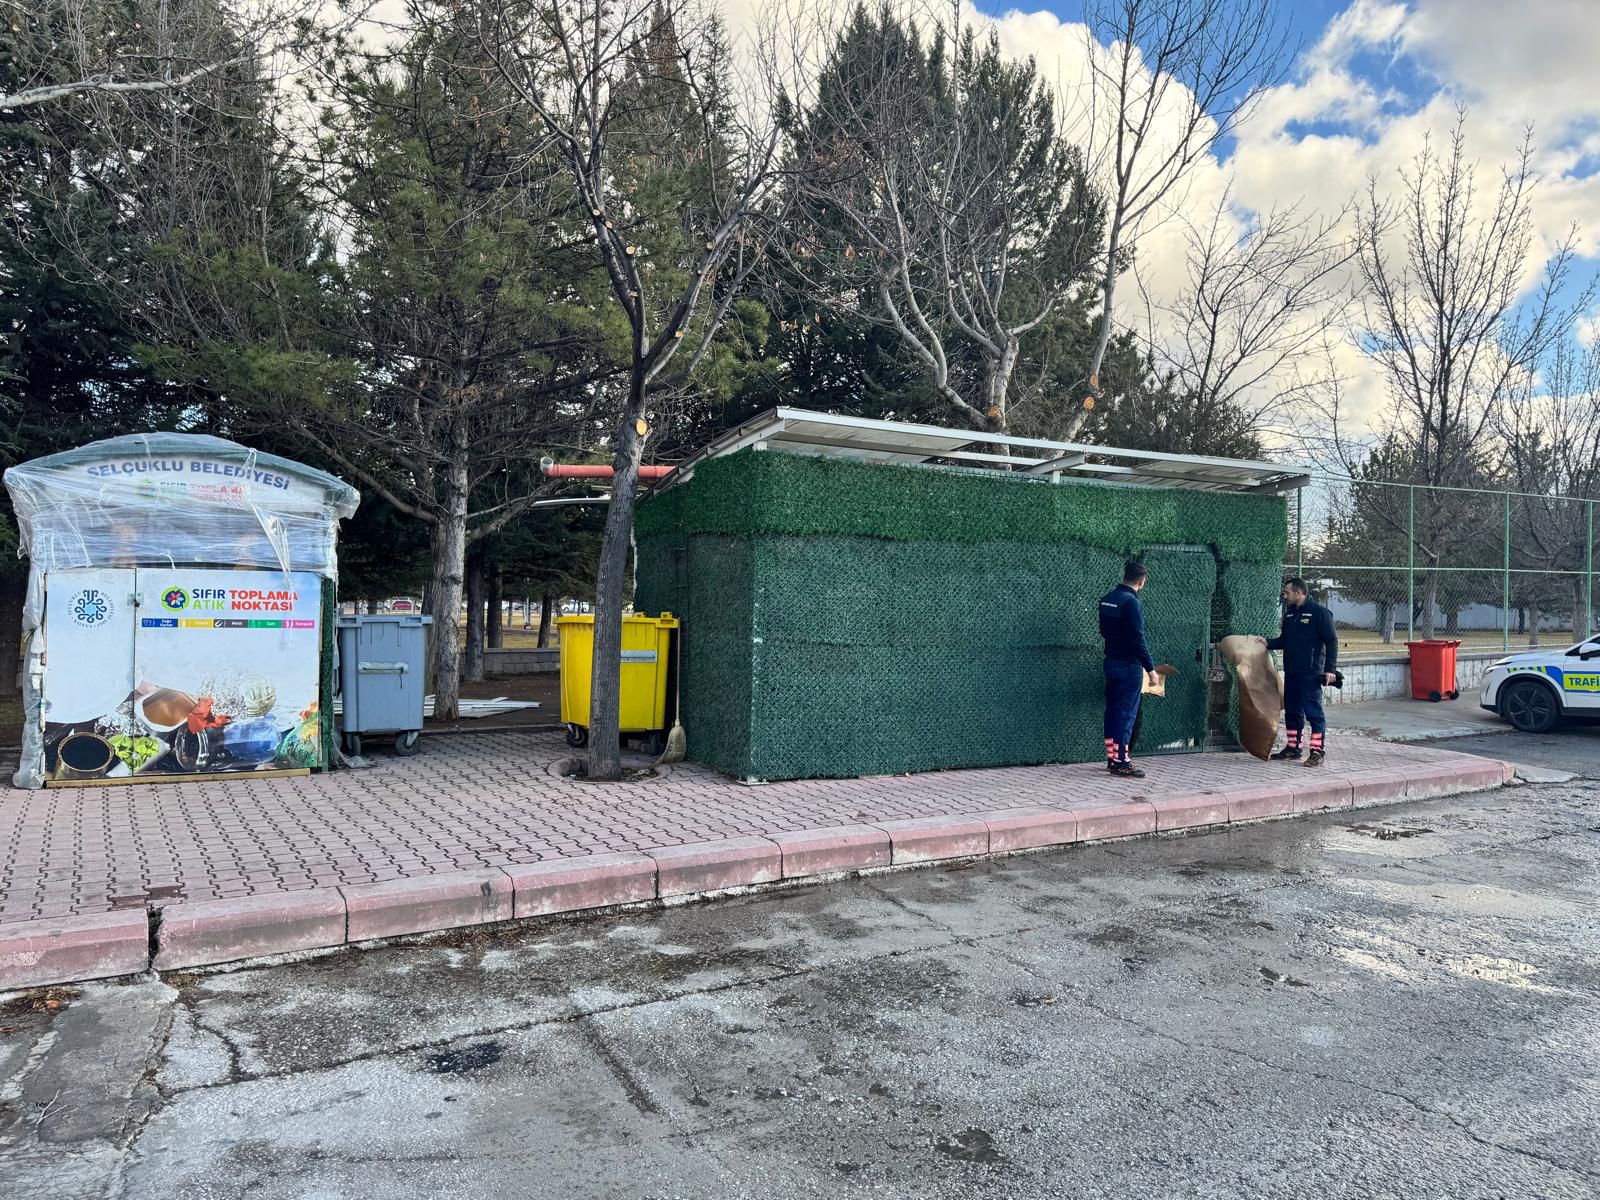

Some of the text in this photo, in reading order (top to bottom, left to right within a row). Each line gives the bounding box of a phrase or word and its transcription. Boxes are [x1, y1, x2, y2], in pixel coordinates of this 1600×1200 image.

[87, 461, 290, 490] SELÇUKLU BELEDİYESİ
[192, 588, 299, 601] SIFIR TOPLAMA
[192, 600, 293, 611] ATIK NOKTASI
[1568, 675, 1600, 687] TRAFİ
